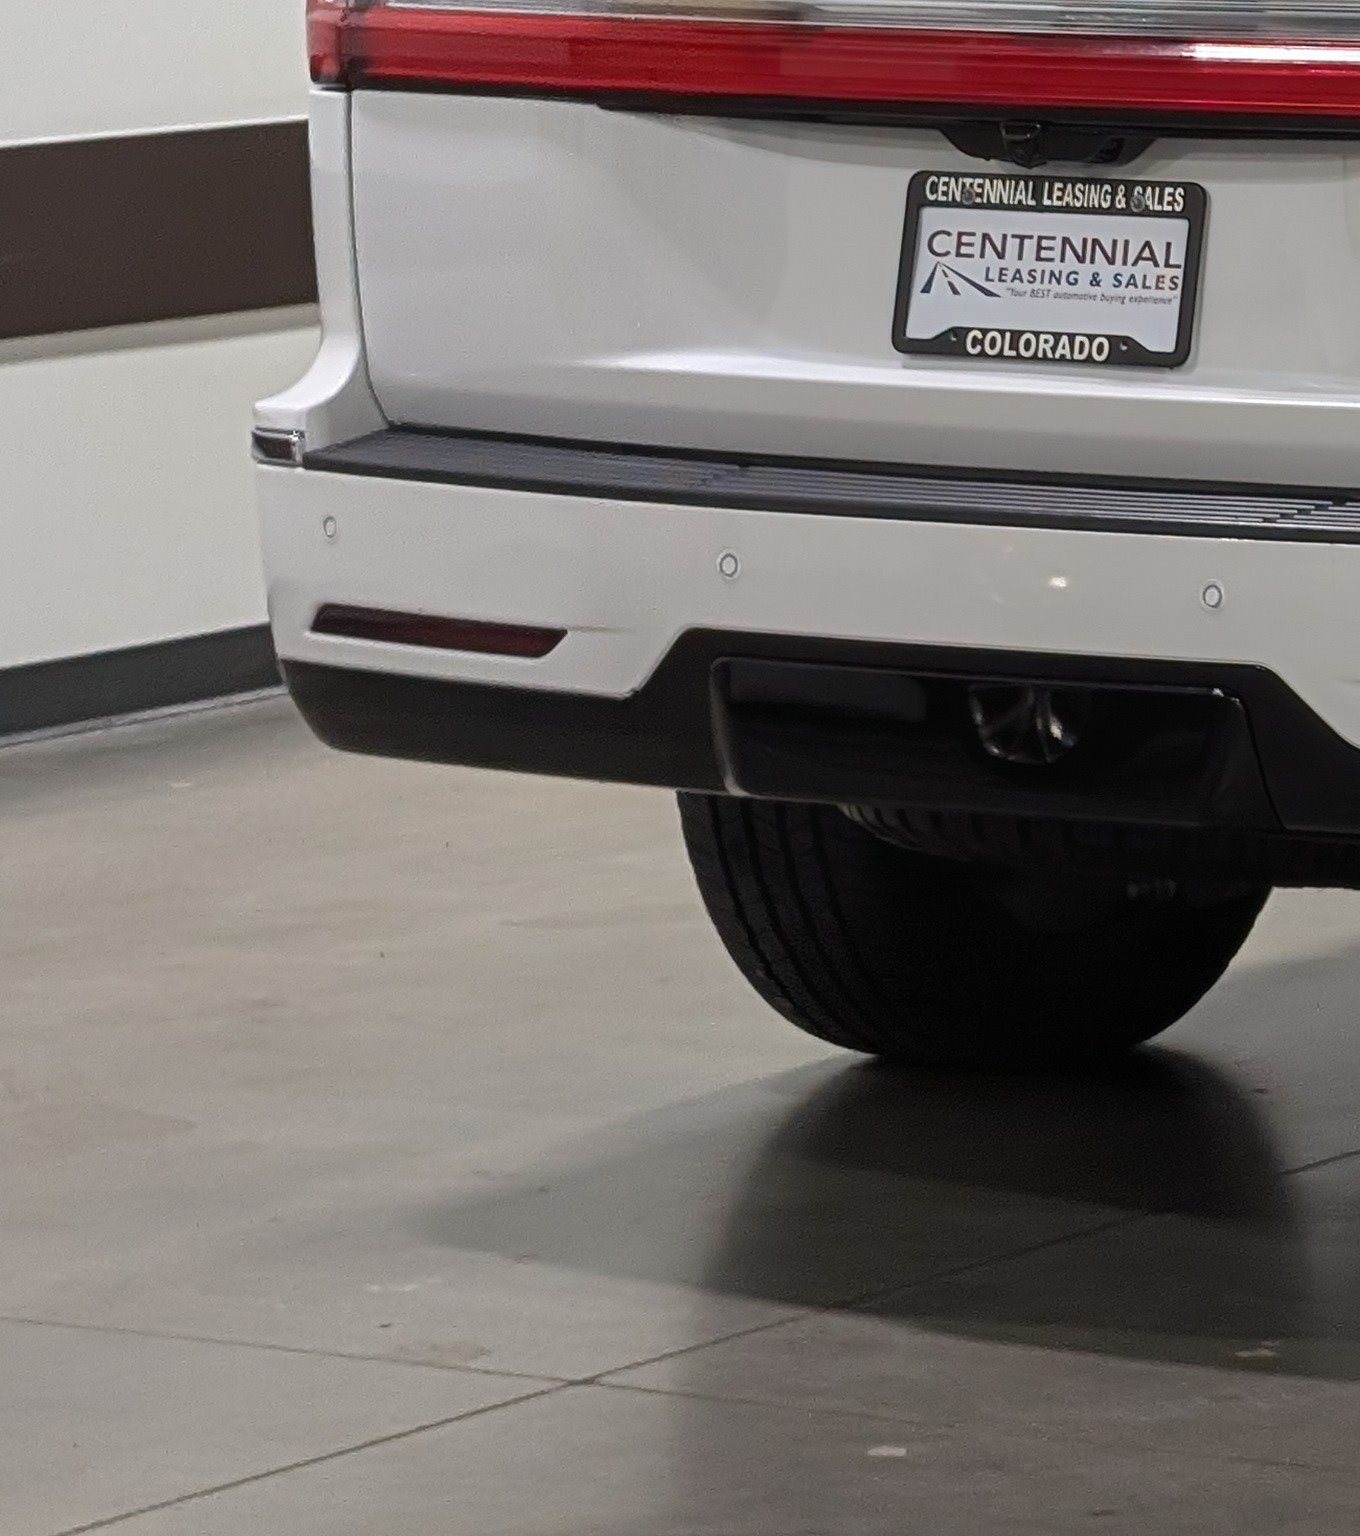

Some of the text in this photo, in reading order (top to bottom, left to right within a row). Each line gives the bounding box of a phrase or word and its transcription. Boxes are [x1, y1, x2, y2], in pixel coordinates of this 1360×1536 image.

[925, 175, 1037, 206] CENTENNIAL
[1042, 181, 1112, 209] LEASING
[1115, 184, 1127, 209] &
[927, 229, 1182, 269] CENTENNIAL
[984, 266, 1180, 291] LEASING & SALES
[1029, 288, 1051, 299] BEST
[1100, 293, 1126, 305] buying
[965, 329, 1110, 362] COLORADO
